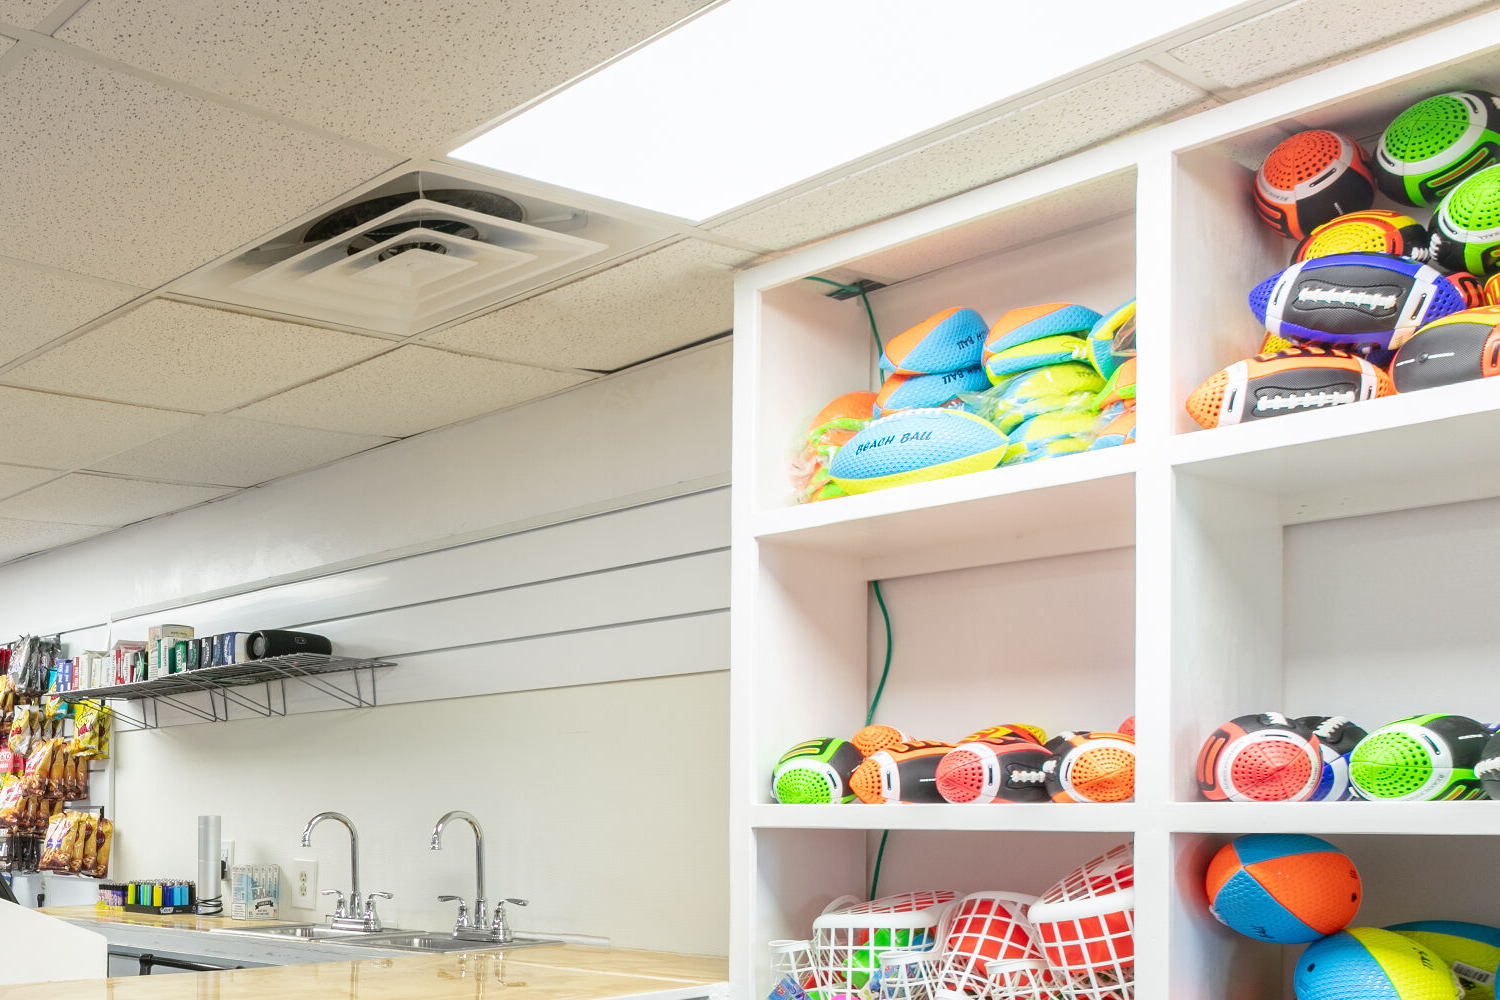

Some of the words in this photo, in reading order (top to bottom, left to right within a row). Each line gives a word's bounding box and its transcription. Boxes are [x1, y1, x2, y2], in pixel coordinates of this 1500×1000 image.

[942, 370, 965, 385] BALL
[855, 434, 896, 456] BEACH
[900, 430, 933, 445] BALL
